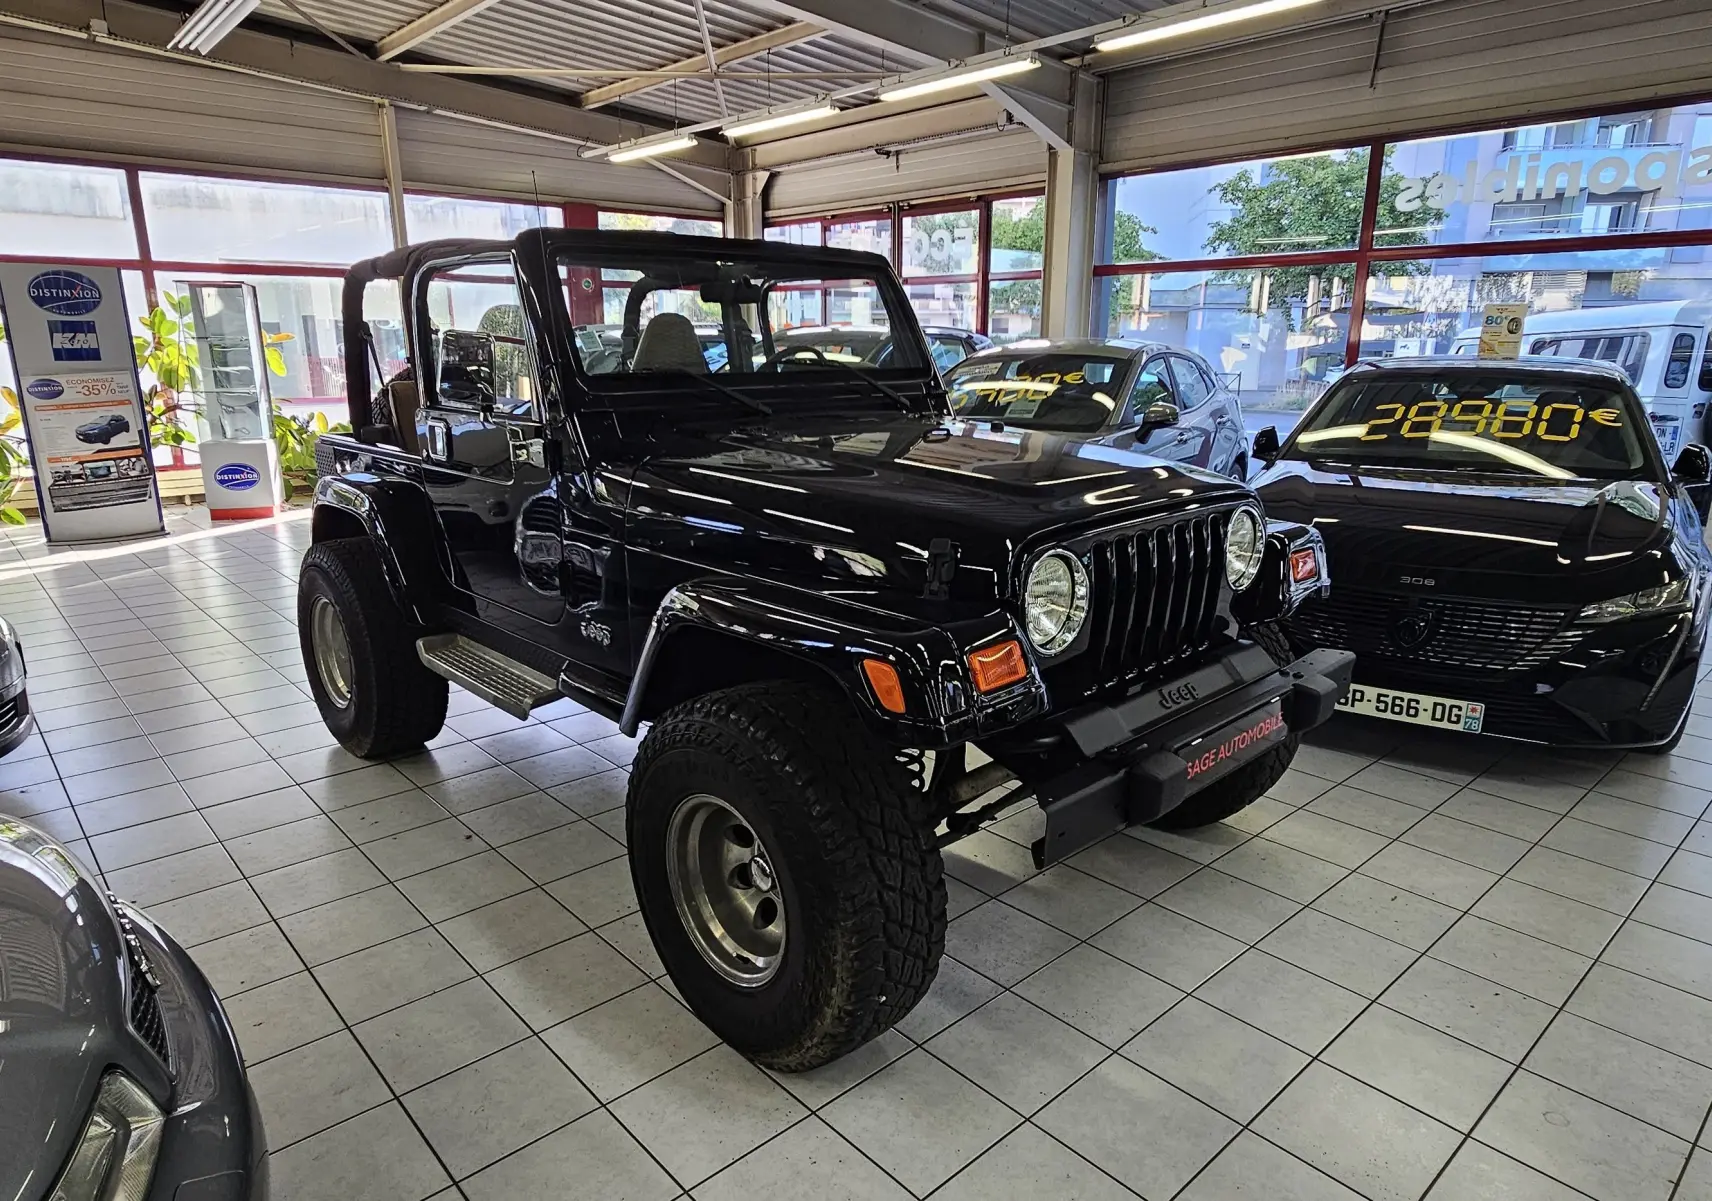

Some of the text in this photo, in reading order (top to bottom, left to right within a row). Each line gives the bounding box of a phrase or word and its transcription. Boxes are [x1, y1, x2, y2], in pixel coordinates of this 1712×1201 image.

[30, 284, 100, 300] DISTINXION
[75, 383, 117, 397] -35%
[216, 472, 258, 480] DISTINXION
[1399, 576, 1436, 587] 308
[1158, 681, 1200, 710] Jeep
[1464, 717, 1479, 731] 78
[1187, 711, 1284, 780] SAGE AUTOMOBILE
